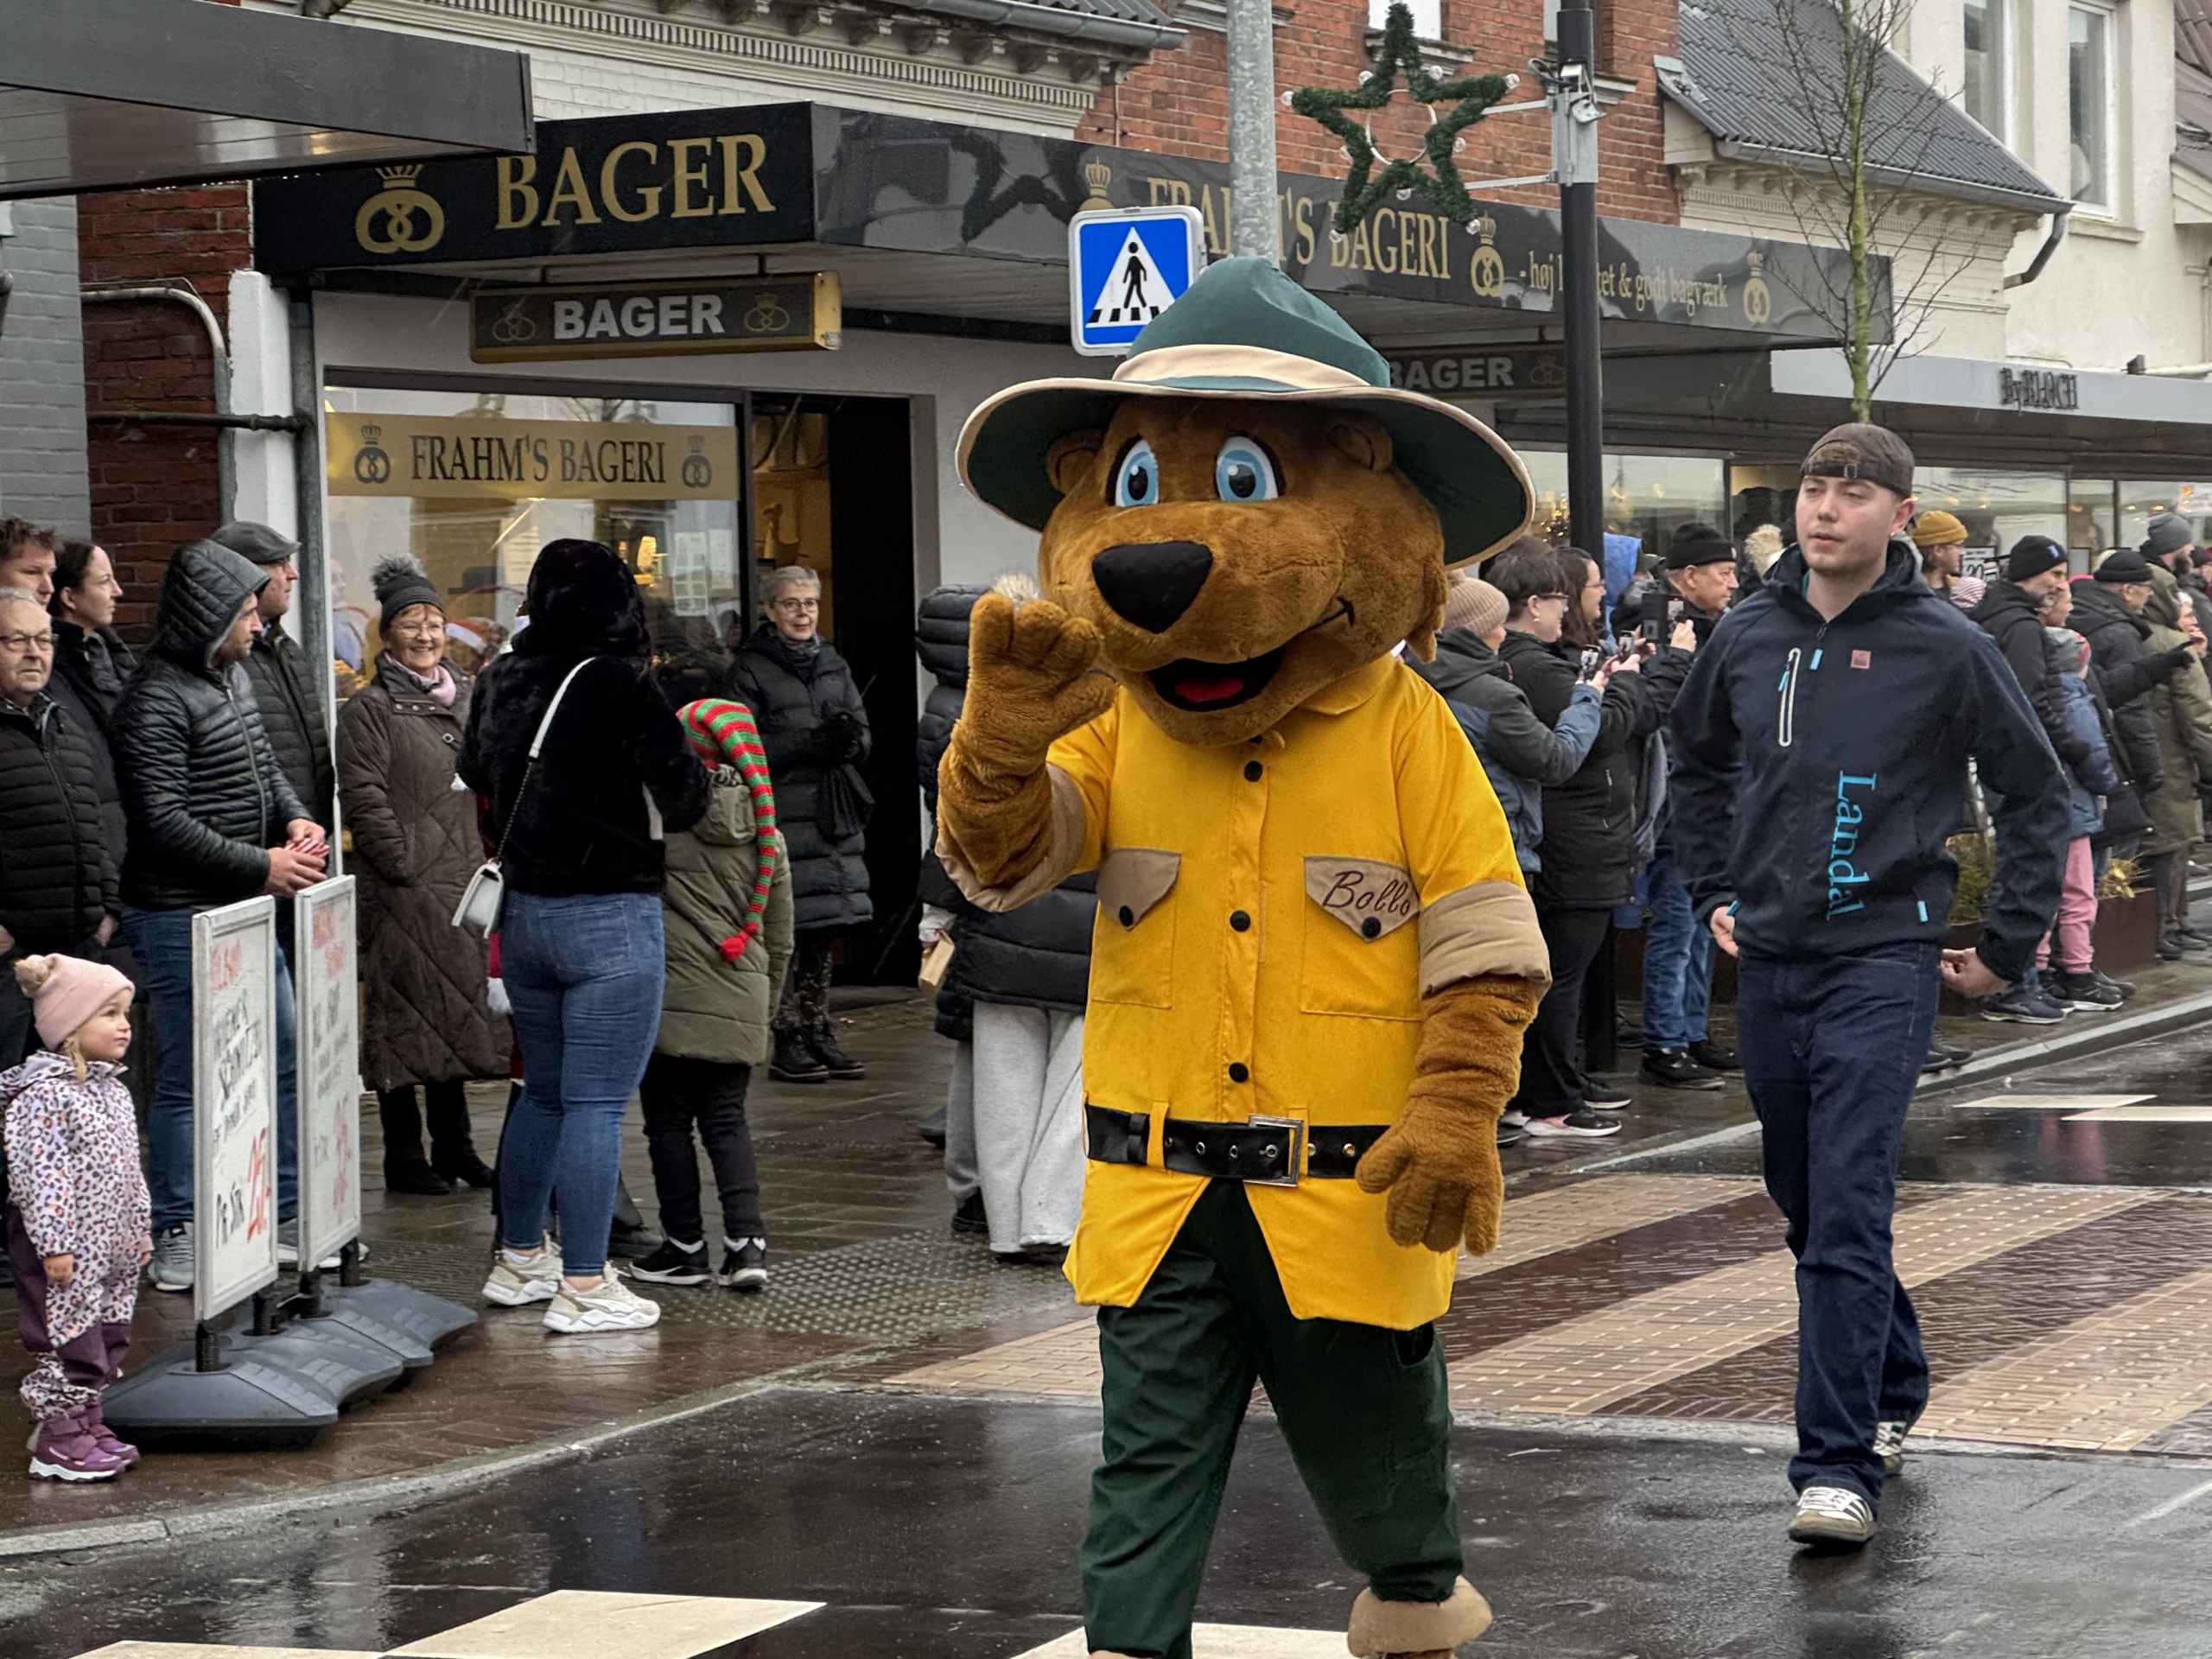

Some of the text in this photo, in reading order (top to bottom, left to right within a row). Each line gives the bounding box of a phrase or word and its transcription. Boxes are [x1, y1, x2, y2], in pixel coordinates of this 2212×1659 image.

[494, 133, 776, 230] BAGER
[1529, 250, 1554, 301] høj
[1618, 262, 1632, 298] &
[553, 294, 724, 340] BAGER
[409, 433, 666, 484] FRAHM'S BAGERI
[1825, 770, 1877, 920] Landal
[1323, 870, 1411, 916] Bollo
